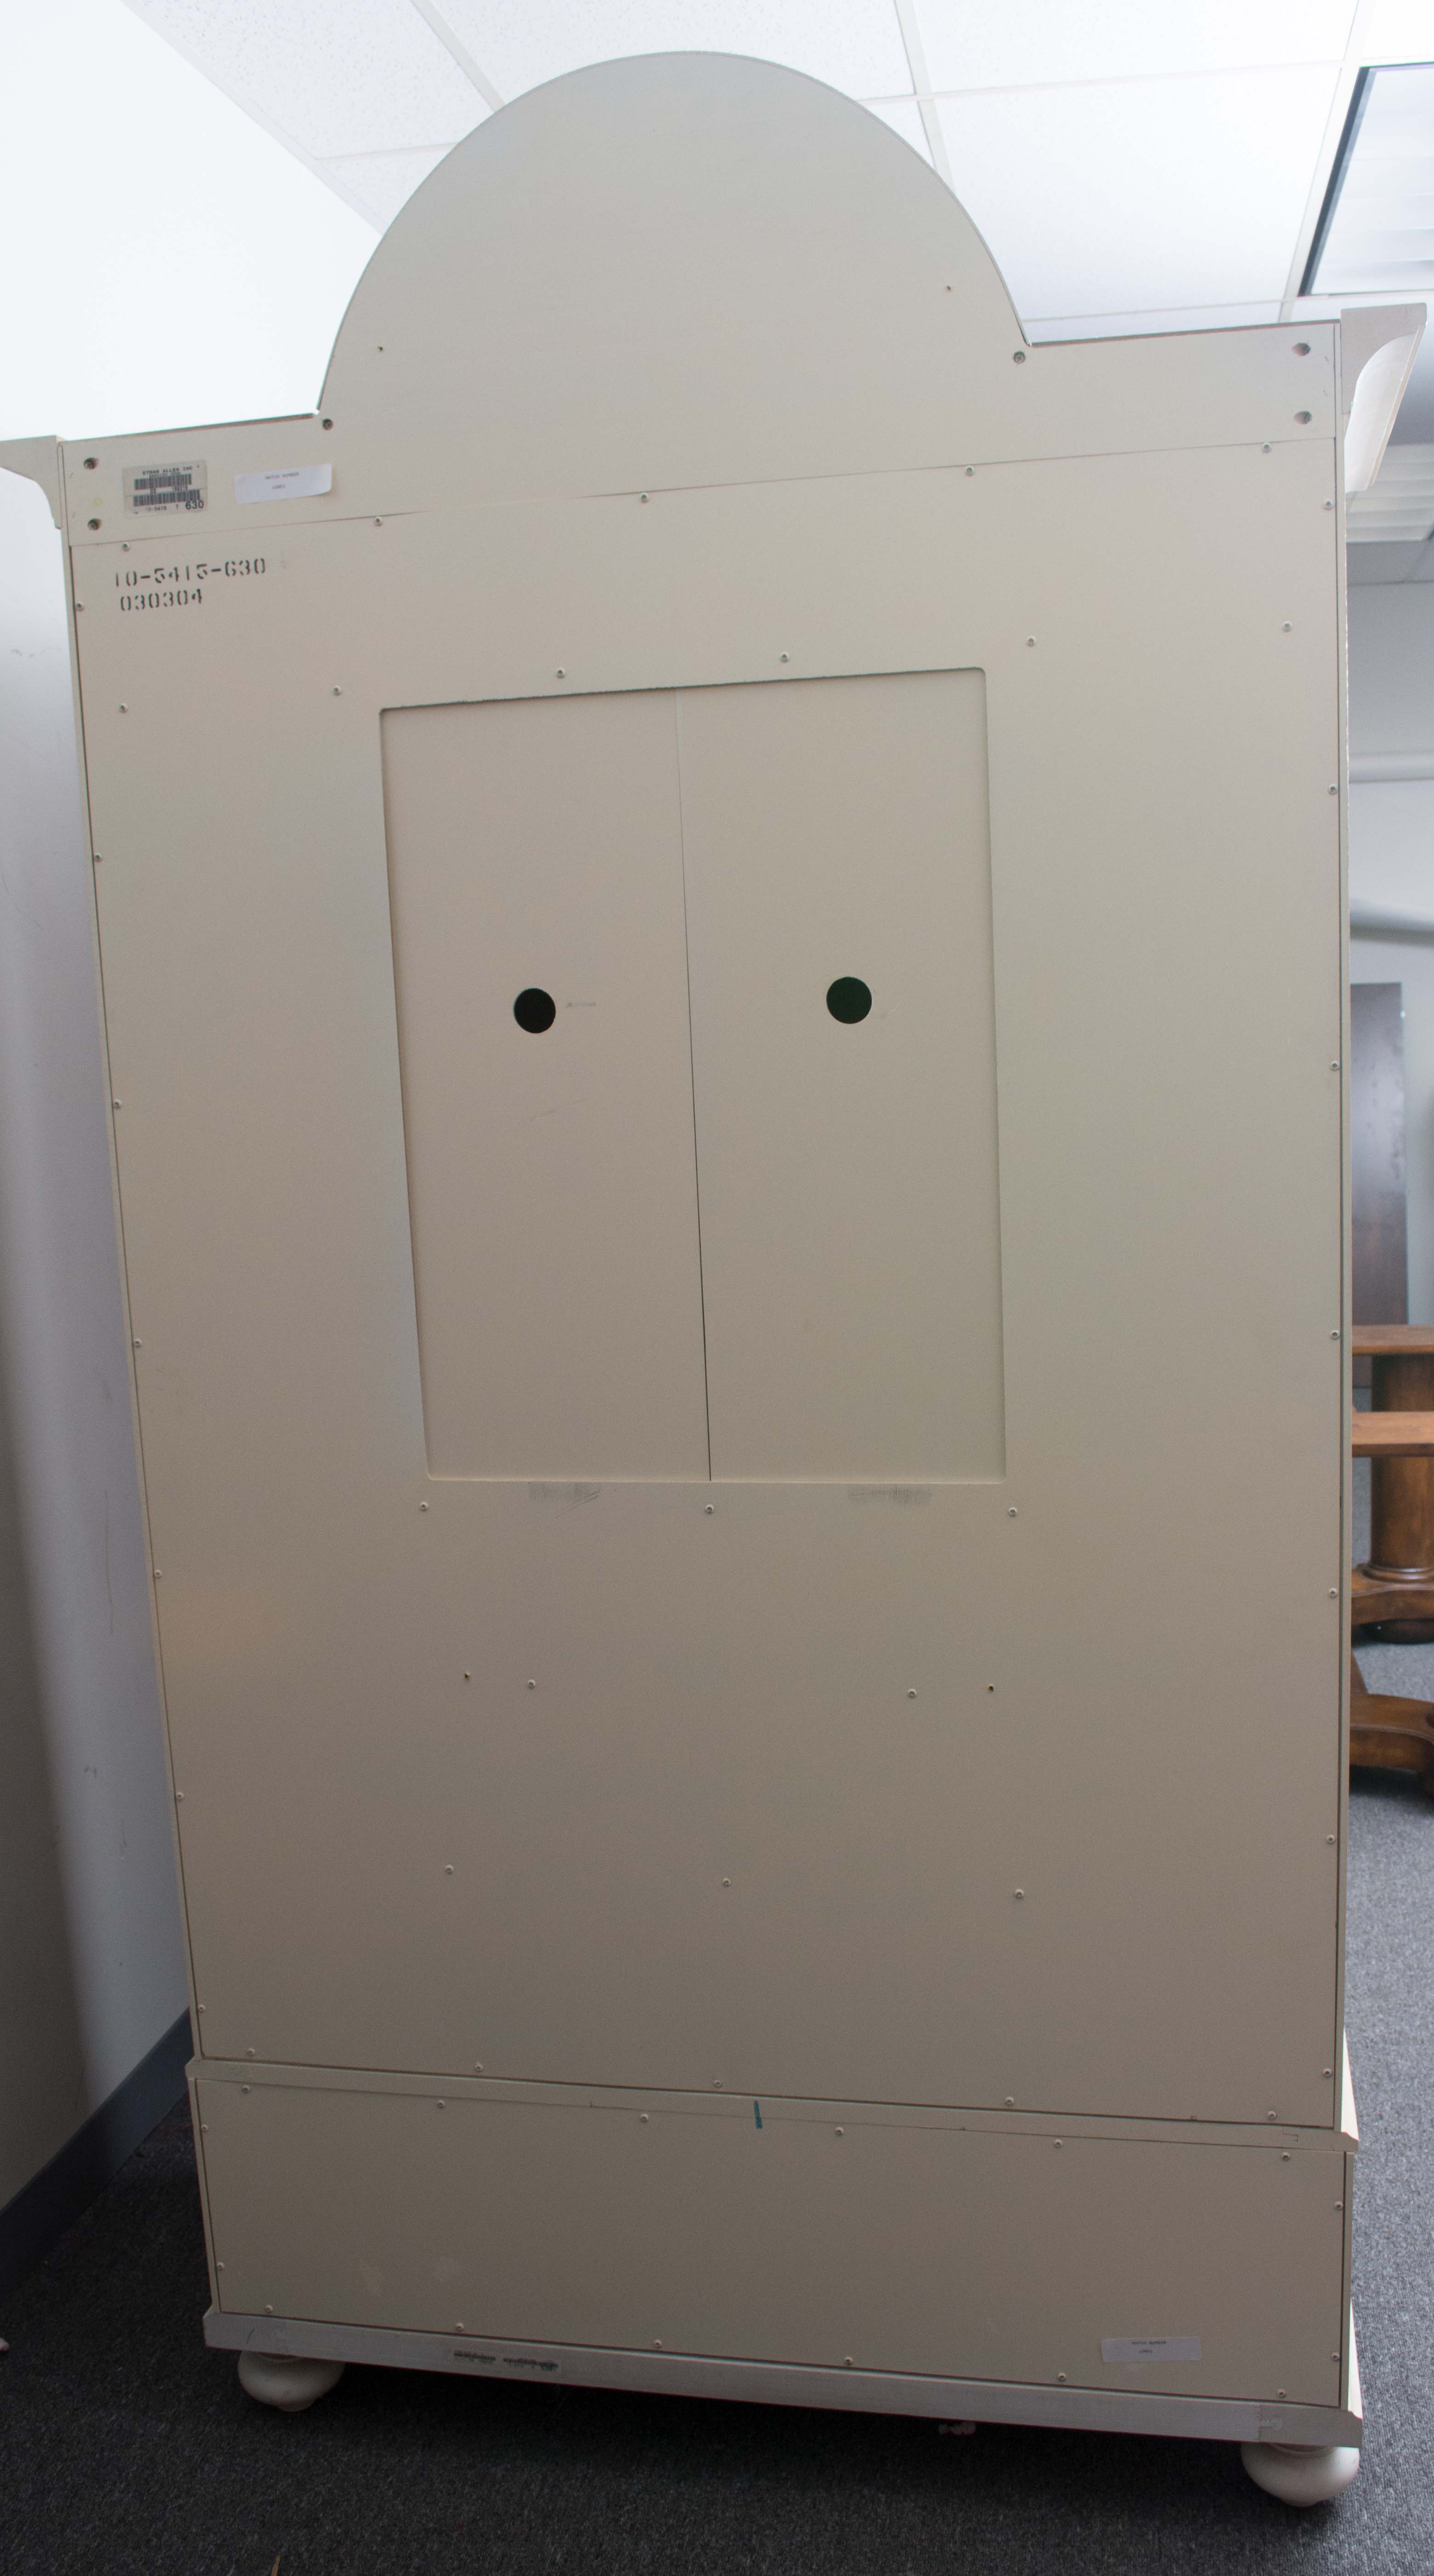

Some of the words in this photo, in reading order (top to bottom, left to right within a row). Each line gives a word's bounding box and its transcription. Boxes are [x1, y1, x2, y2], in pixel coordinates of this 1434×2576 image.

[185, 500, 204, 510] 630
[115, 558, 265, 587] 10-5415-630
[120, 588, 202, 611] 030304
